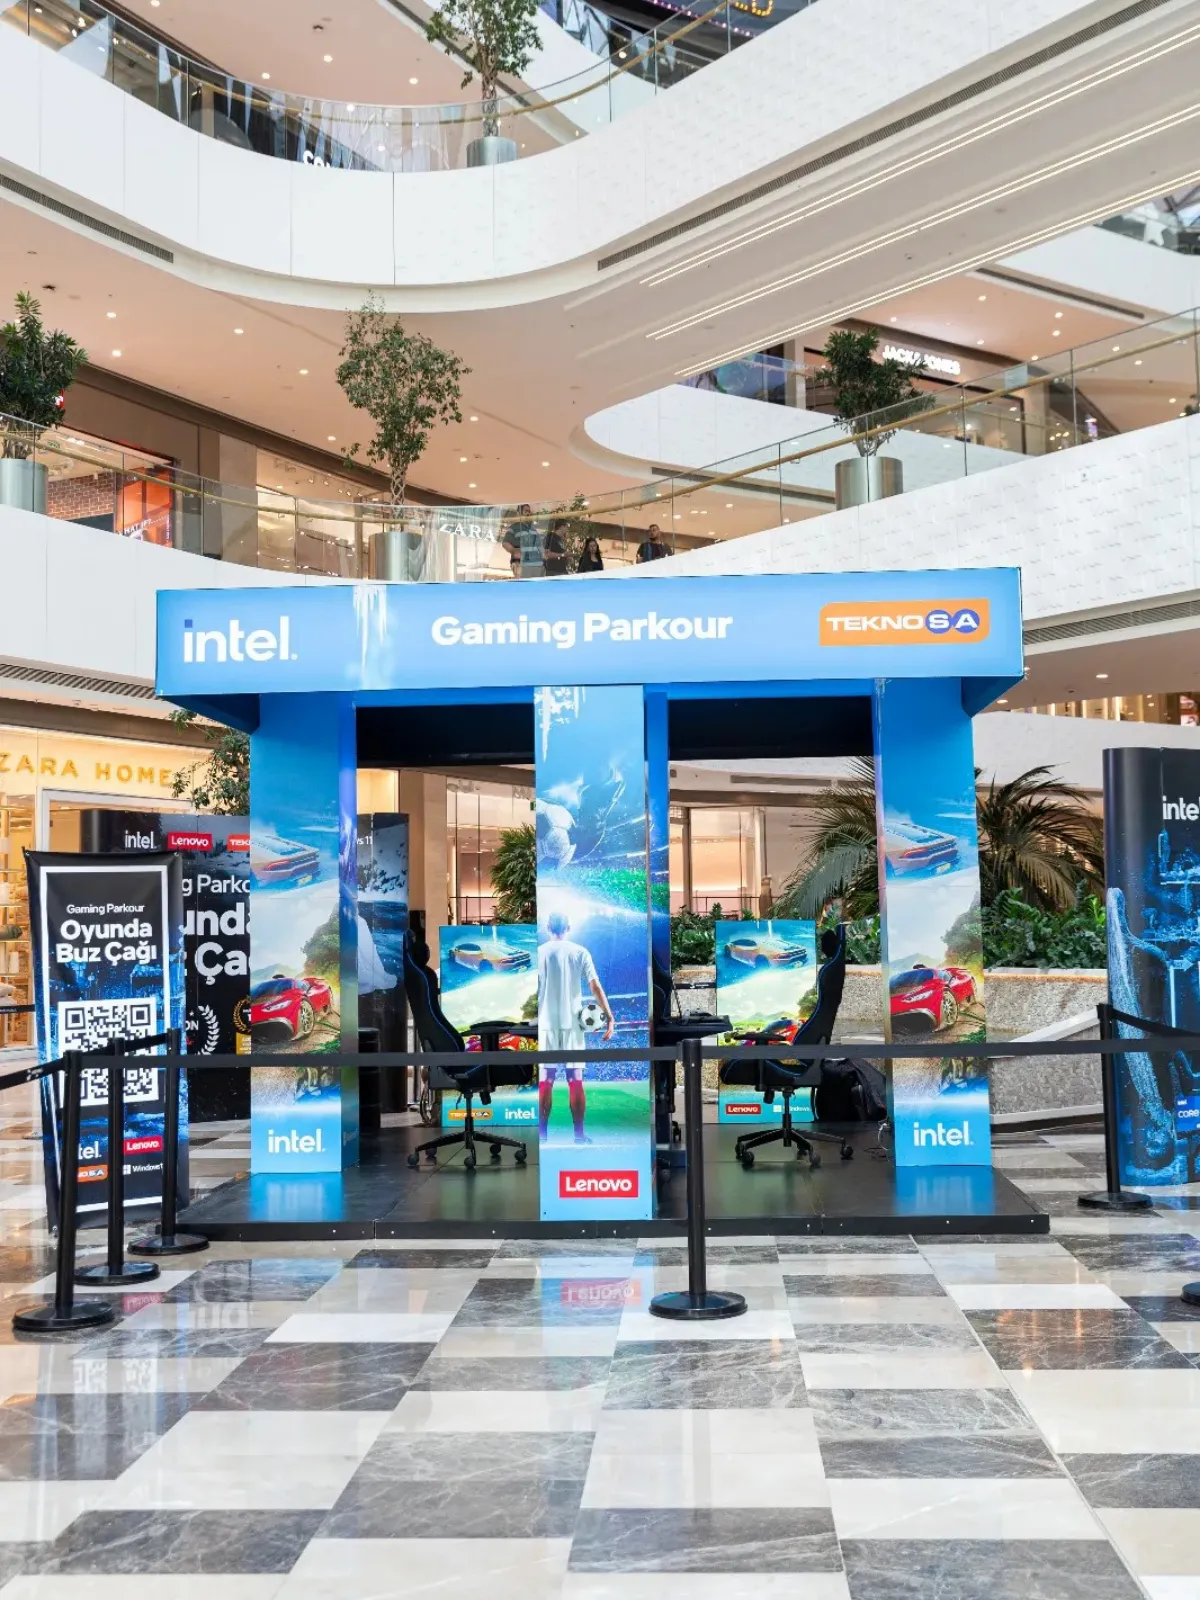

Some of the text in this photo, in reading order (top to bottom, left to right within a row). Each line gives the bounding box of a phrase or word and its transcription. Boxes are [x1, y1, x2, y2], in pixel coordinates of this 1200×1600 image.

[440, 522, 497, 543] ZARA
[431, 612, 733, 649] Gaming Parkour
[825, 612, 979, 632] TEKNOSA
[0, 752, 173, 787] ZARA HOME
[171, 836, 208, 847] Lenovo
[229, 838, 250, 846] TEK
[182, 874, 250, 897] g Parko
[66, 903, 145, 915] Gaming Parkour
[60, 918, 153, 944] Oyunda
[56, 943, 101, 963] Buz
[104, 940, 157, 966] Çağı
[194, 942, 250, 986] Ça
[728, 1105, 758, 1113] Lenovo
[126, 1140, 160, 1151] Lenovo
[565, 1176, 632, 1192] Lenovo
